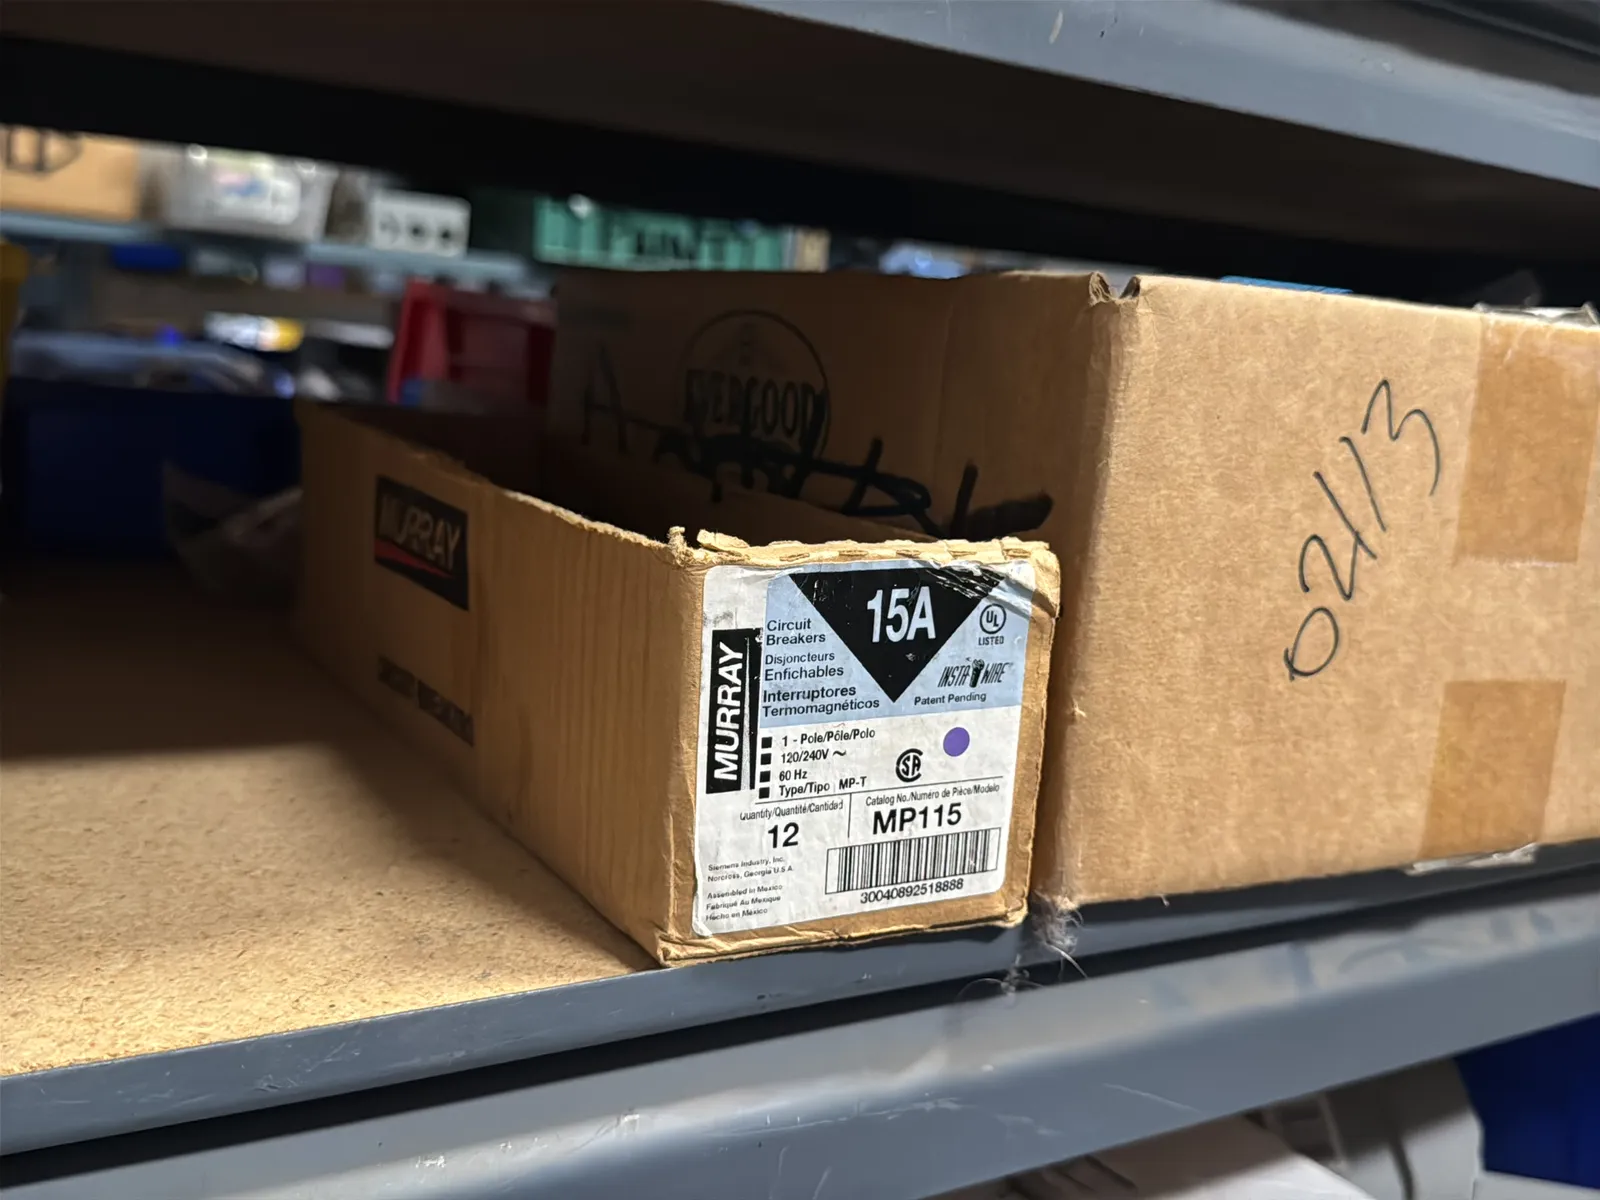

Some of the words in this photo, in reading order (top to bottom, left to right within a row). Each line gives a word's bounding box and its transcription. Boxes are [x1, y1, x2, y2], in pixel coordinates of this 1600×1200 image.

[867, 586, 936, 643] 15A
[767, 618, 812, 632] Circuit
[766, 633, 826, 646] Breakers
[978, 635, 1004, 646] LISTED
[765, 652, 835, 666] Disjoncteurs
[764, 665, 844, 682] Enfichables
[938, 664, 970, 688] INSTA
[980, 662, 1010, 685] WIRE
[763, 686, 856, 703] Interruptores
[914, 696, 945, 706] Patent
[948, 692, 987, 705] Pending
[713, 641, 744, 781] MURRAY
[762, 699, 880, 718] Termomagnéticos
[781, 735, 788, 747] 1
[800, 728, 876, 745] Pole/Pôle/Polo
[781, 748, 830, 764] 120/240V
[779, 770, 792, 782] 60
[794, 769, 808, 780] Hz
[779, 782, 830, 798] Type/Tipo
[839, 776, 868, 790] MP-T
[865, 796, 895, 807] Catalog
[941, 787, 951, 799] de
[873, 802, 962, 835] MP115
[768, 822, 800, 849] 12
[708, 862, 739, 872] Siemens
[744, 869, 772, 878] Georgia
[749, 886, 756, 894] in
[860, 878, 964, 904] 30040892518888
[706, 912, 730, 921] Hecho
